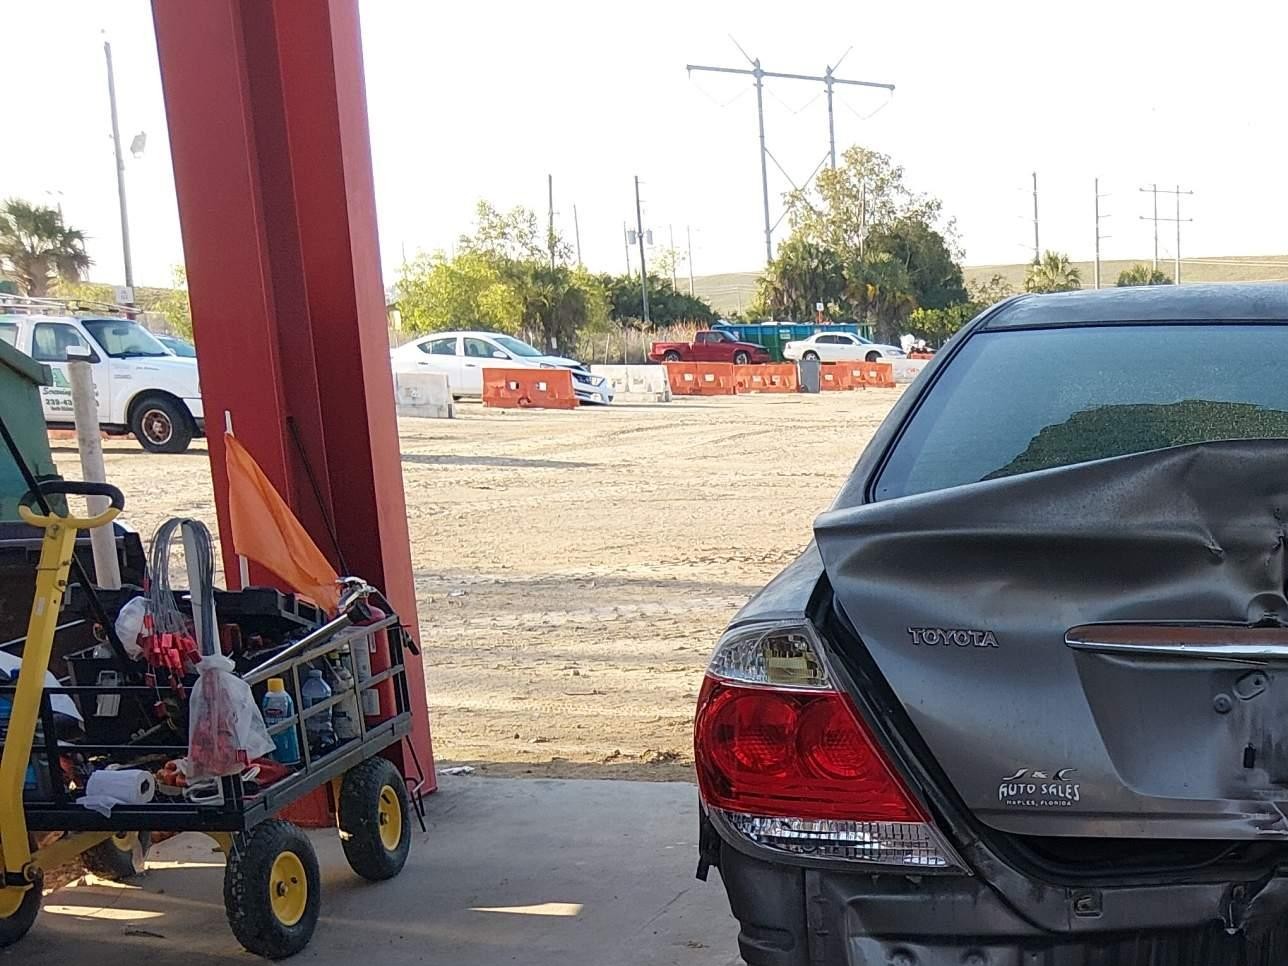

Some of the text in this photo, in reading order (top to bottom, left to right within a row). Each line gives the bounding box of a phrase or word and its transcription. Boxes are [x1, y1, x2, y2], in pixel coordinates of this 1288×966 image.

[908, 627, 999, 648] TOYOTA
[998, 783, 1080, 801] AUTO SALES
